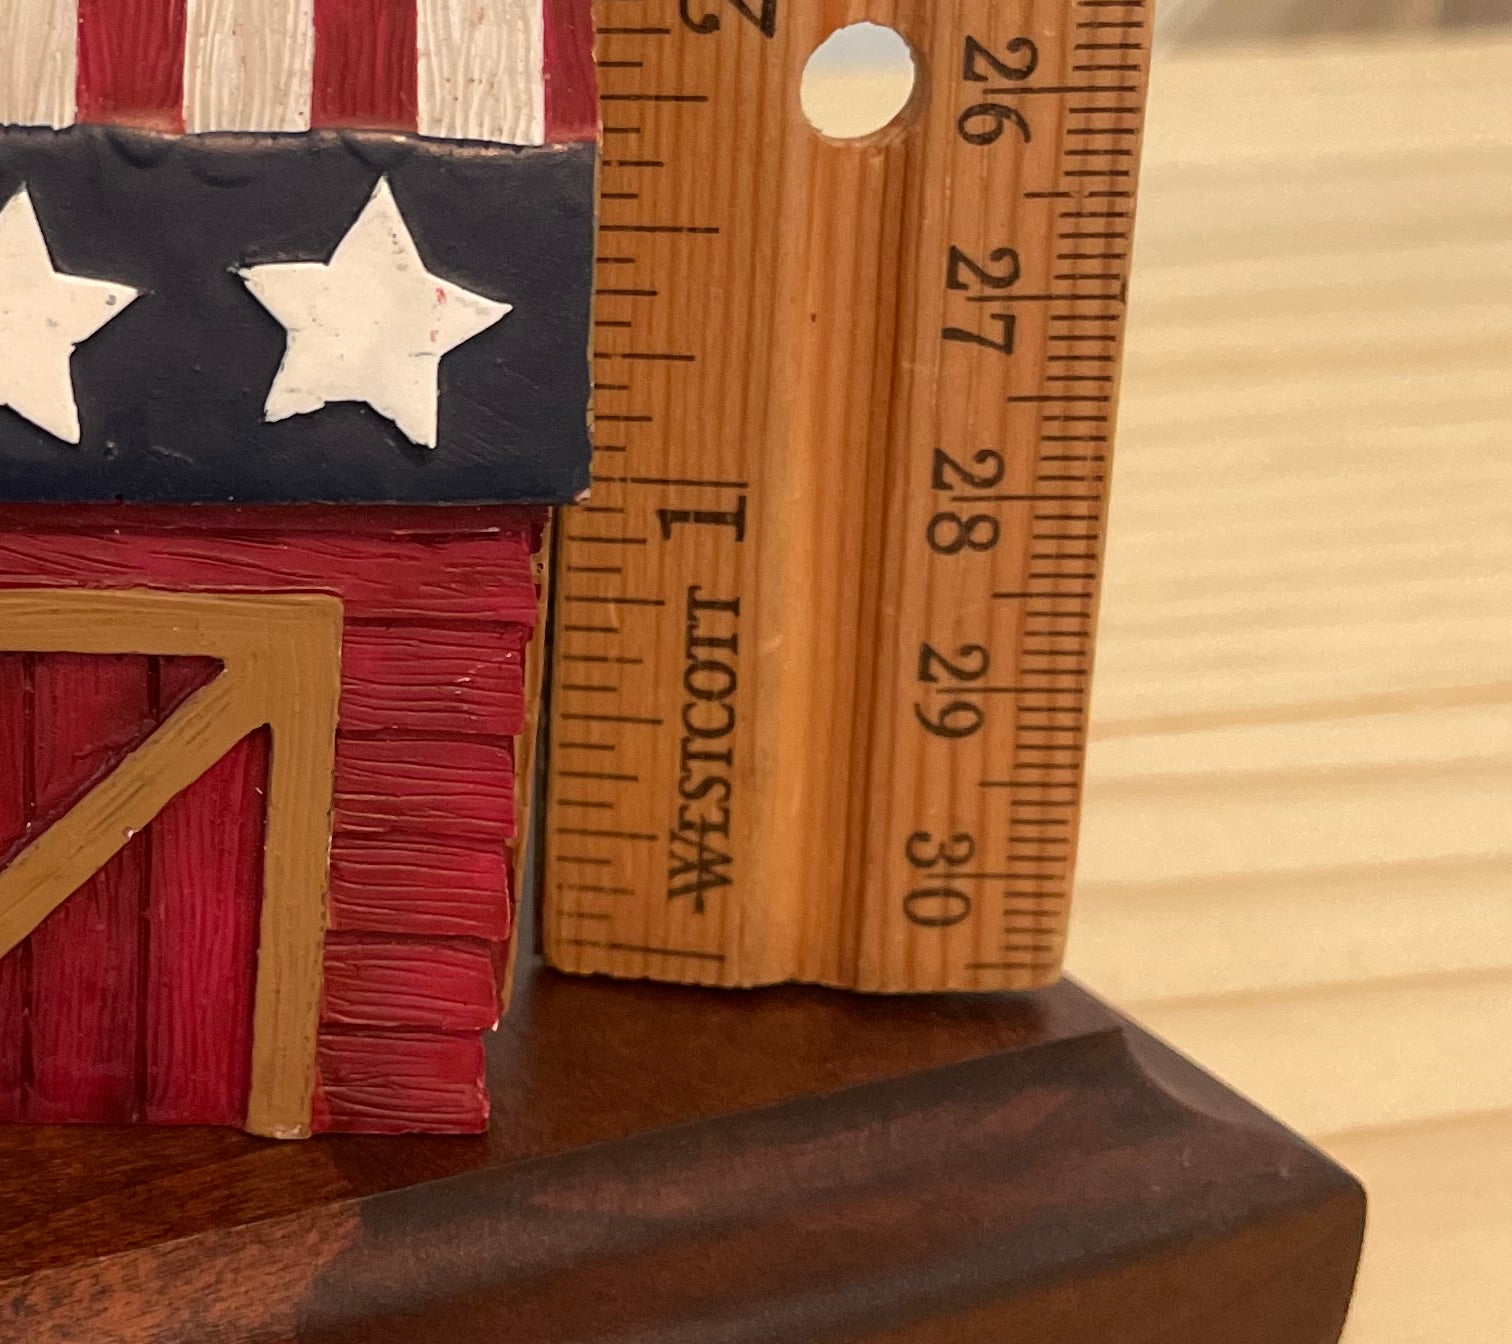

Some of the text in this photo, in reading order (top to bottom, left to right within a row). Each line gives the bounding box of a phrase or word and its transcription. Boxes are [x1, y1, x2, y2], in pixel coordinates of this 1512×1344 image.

[957, 36, 1039, 145] 26
[941, 246, 1022, 355] 27
[655, 495, 747, 543] 1
[926, 448, 1006, 555] 28
[915, 643, 989, 739] 29
[668, 585, 742, 915] WESTCOTT
[902, 830, 975, 927] 30
